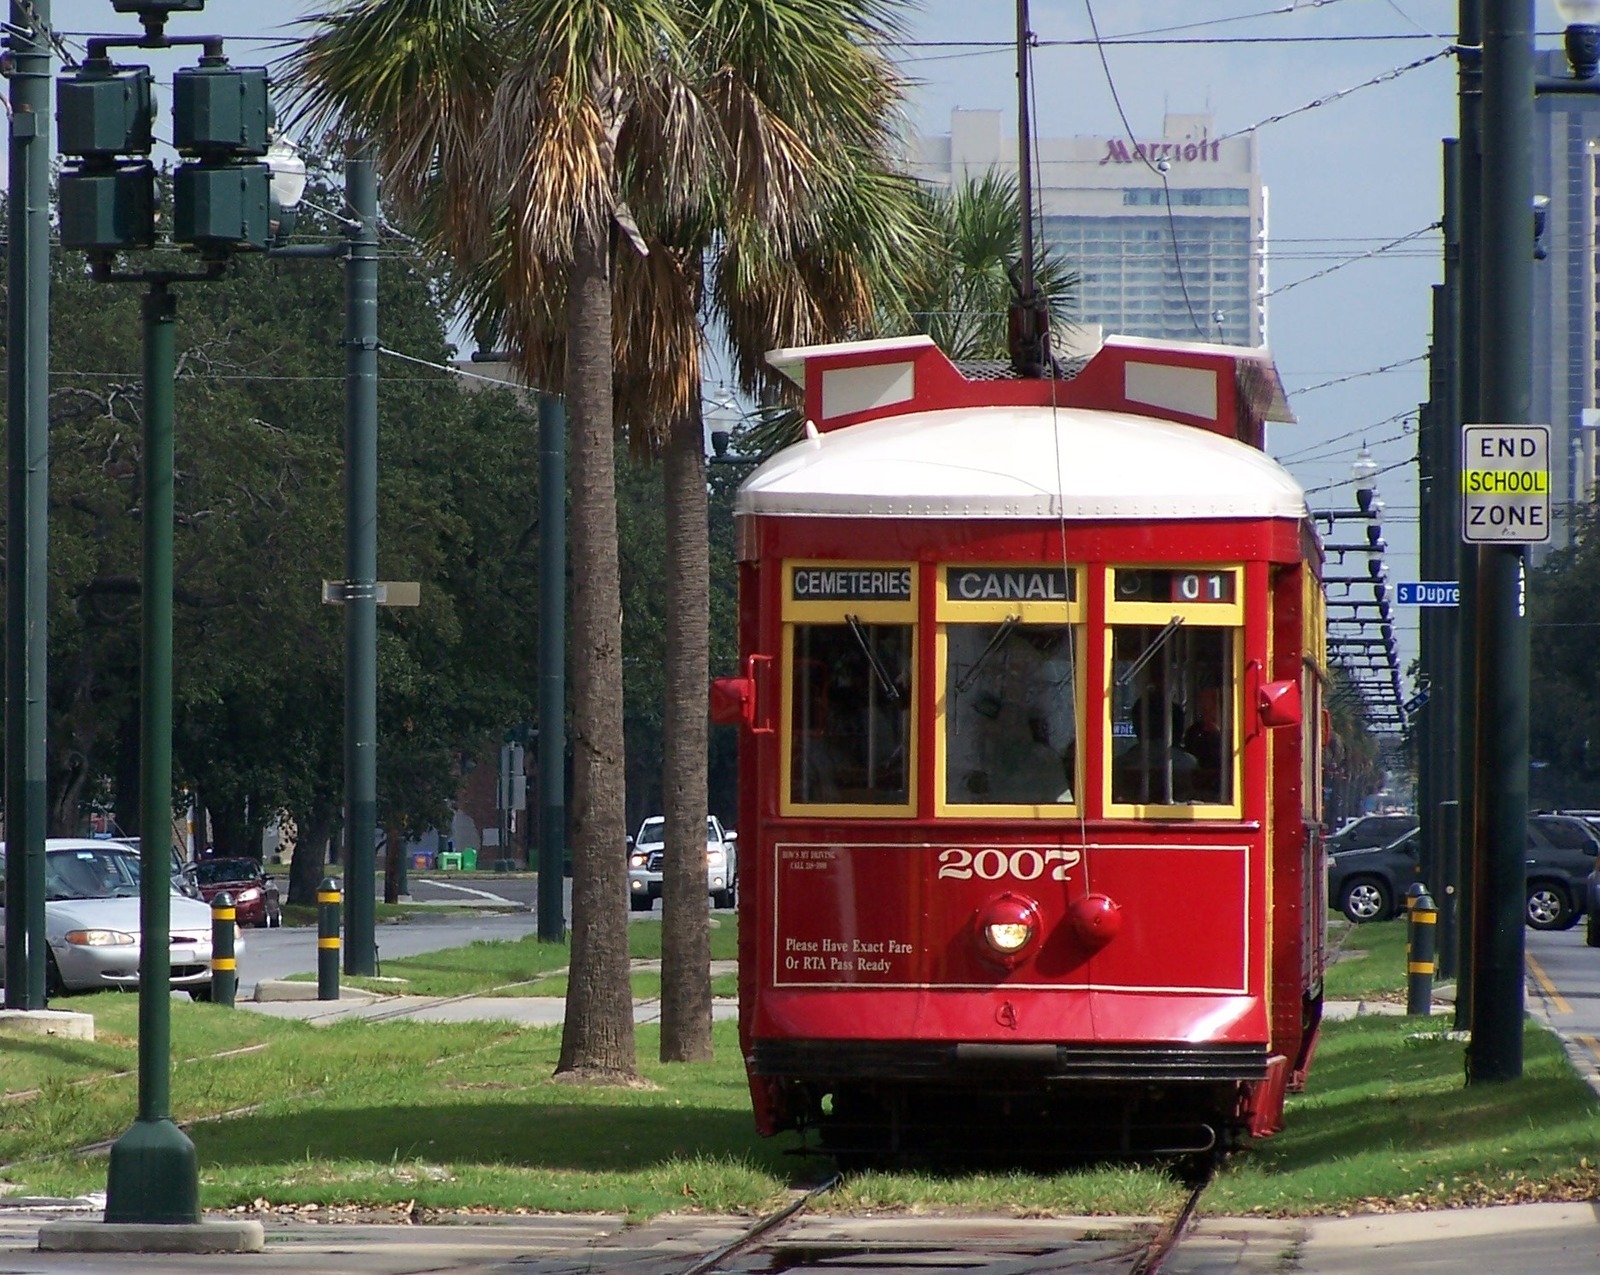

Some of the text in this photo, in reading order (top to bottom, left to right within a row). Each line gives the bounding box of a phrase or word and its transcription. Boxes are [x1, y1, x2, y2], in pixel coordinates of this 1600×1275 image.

[1099, 139, 1221, 165] Marriott
[1481, 438, 1536, 457] END
[1470, 471, 1545, 491] SCHOOL
[1470, 505, 1543, 525] ZONE
[795, 571, 911, 594] CEMETERIES
[959, 573, 1065, 599] CANAL
[1400, 585, 1460, 603] S Dupre
[938, 849, 1081, 880] 2007
[786, 938, 913, 954] Please Have Exact Fare
[786, 956, 891, 973] Or RTA Pass Ready
